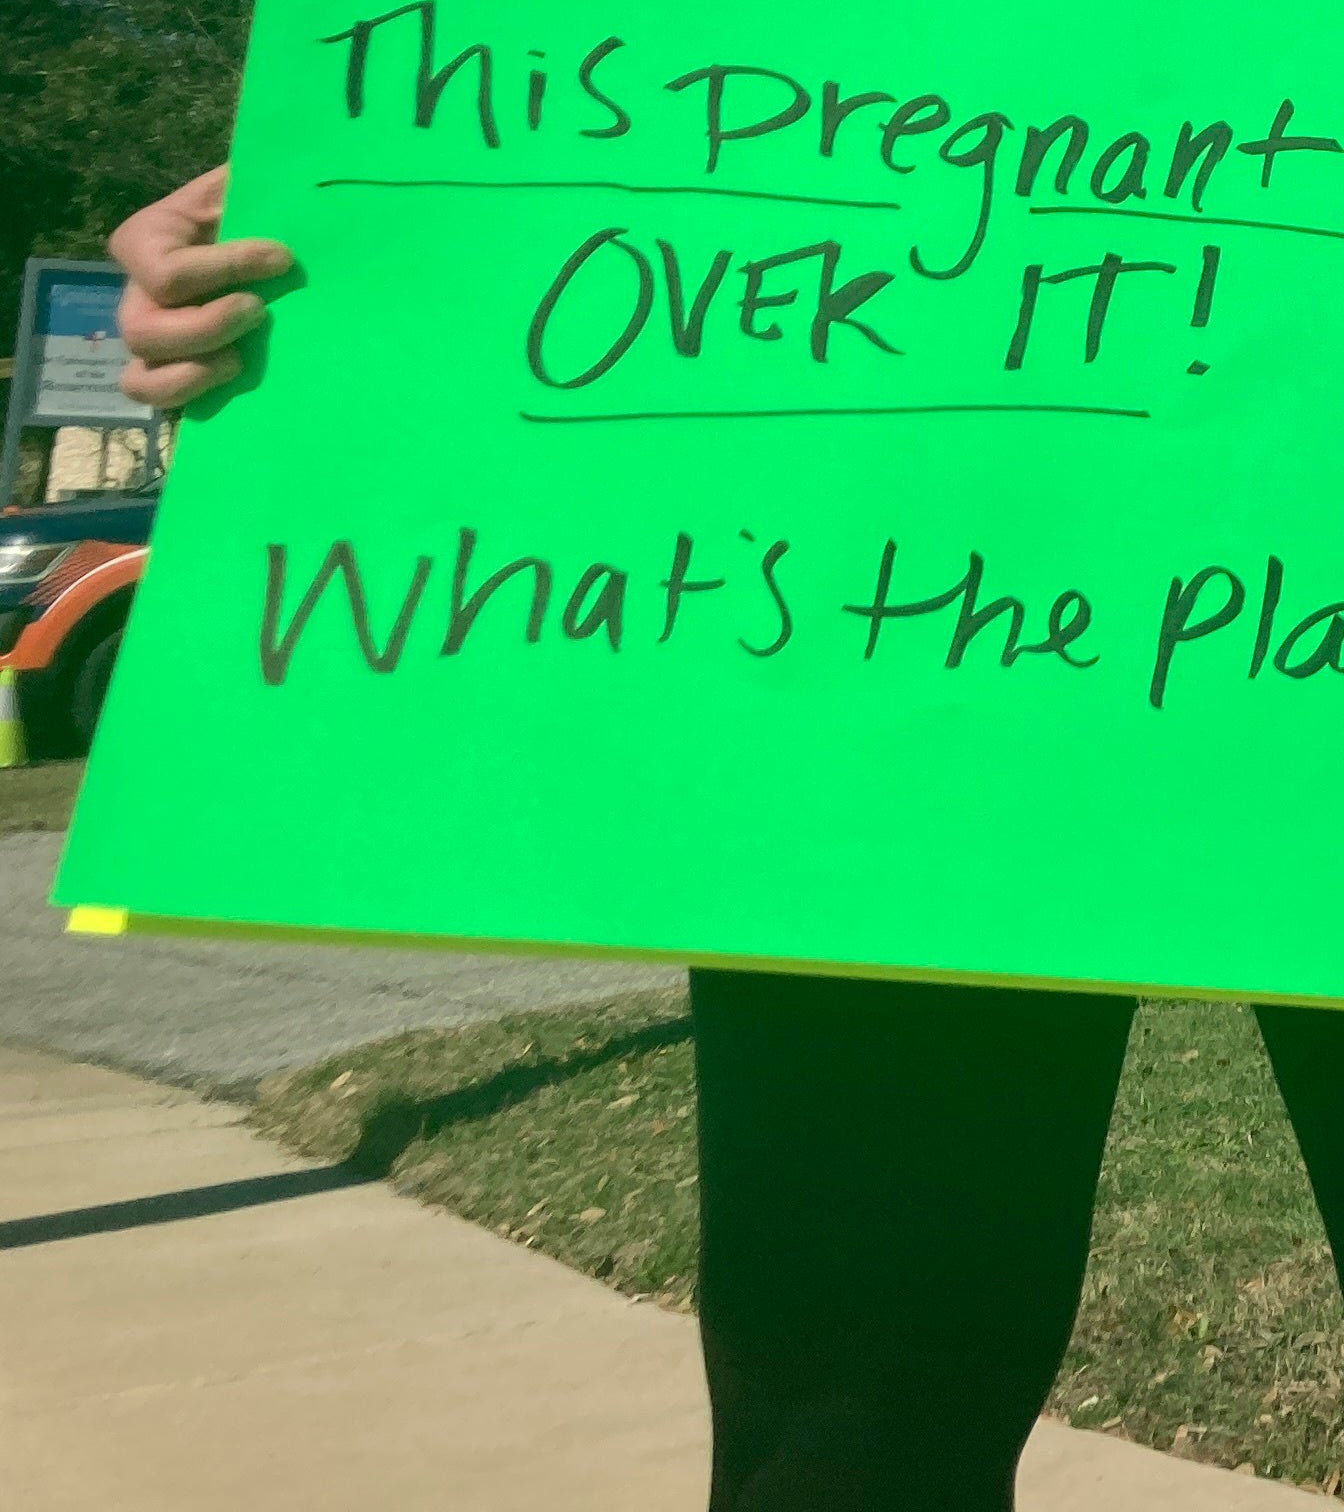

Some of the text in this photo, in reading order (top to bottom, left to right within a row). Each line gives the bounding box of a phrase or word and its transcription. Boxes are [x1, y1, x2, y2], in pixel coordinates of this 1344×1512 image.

[321, 1, 630, 149] This
[527, 229, 1220, 389] OVER IT!
[260, 529, 791, 686] What's
[843, 540, 1098, 669] the
